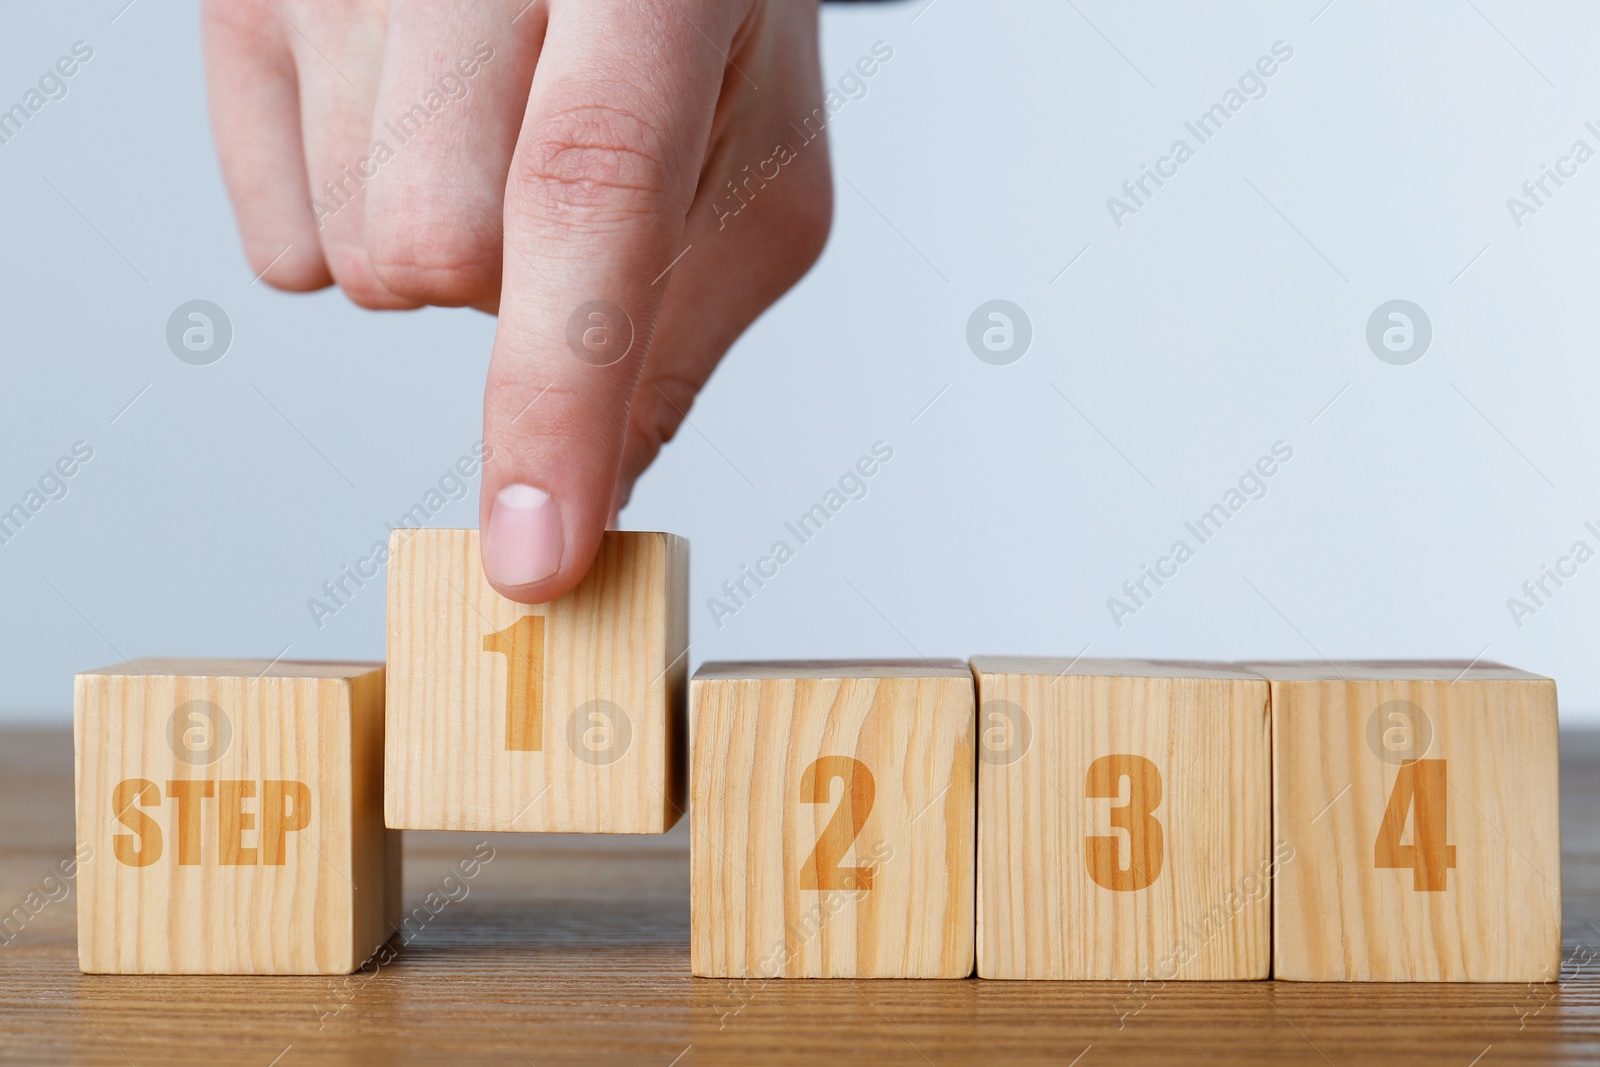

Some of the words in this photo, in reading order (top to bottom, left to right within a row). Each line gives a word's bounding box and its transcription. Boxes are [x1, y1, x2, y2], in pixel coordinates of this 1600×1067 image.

[482, 615, 545, 751] 1
[112, 778, 311, 867] STEP
[800, 755, 876, 890] 2
[1085, 754, 1163, 891] 3
[1374, 759, 1456, 891] 4
